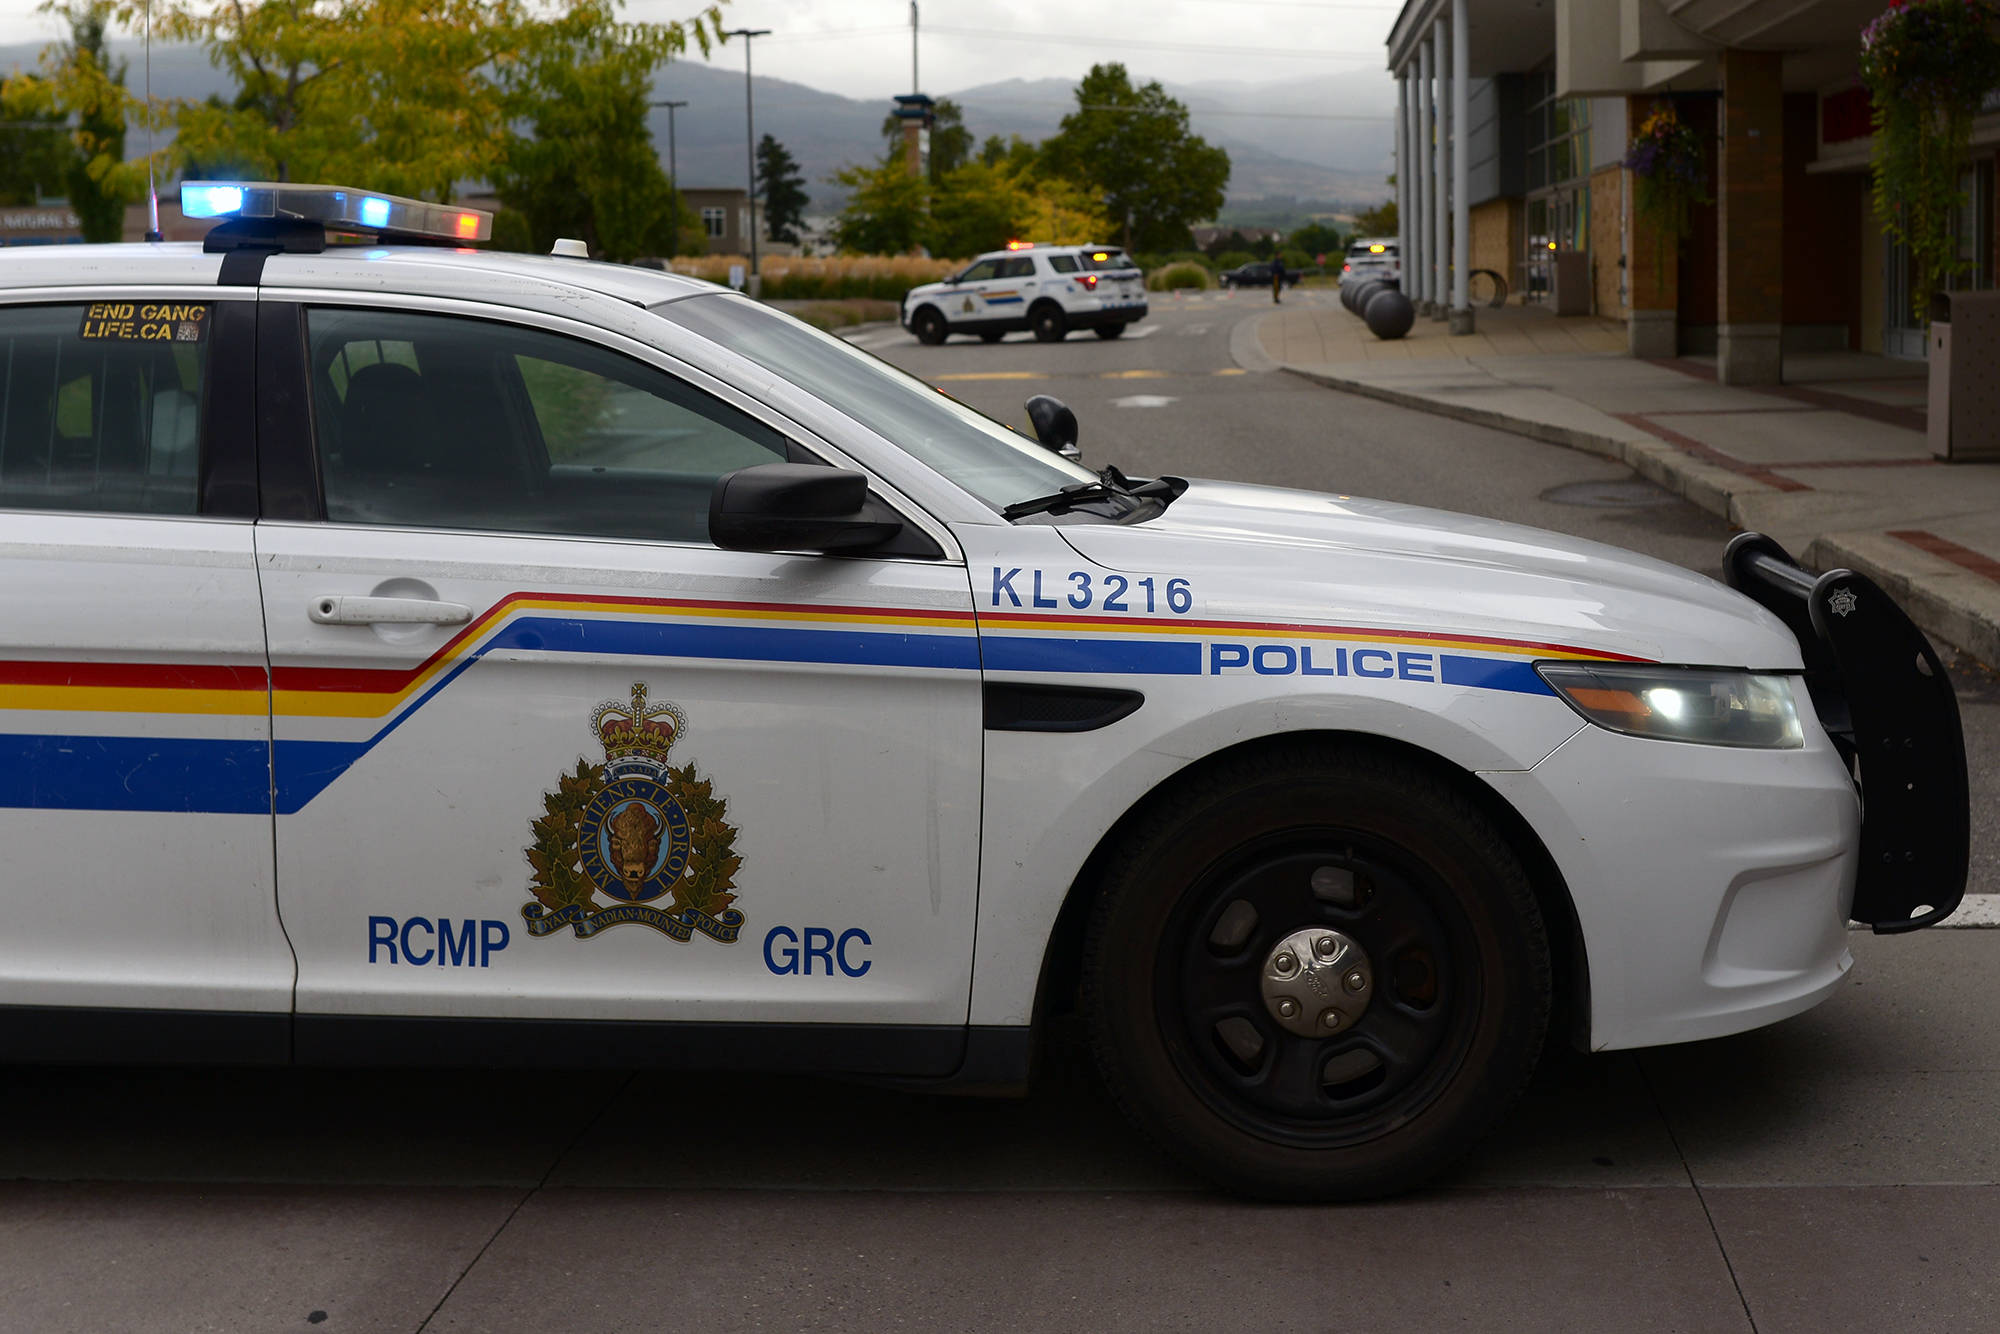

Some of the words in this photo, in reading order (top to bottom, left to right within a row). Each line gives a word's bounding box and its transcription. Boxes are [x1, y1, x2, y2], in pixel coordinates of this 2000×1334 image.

[83, 321, 172, 340] LIFE.CA
[88, 303, 135, 320] END
[140, 304, 206, 321] GANG
[991, 566, 1193, 614] KL3216
[1210, 643, 1436, 683] POLICE
[614, 764, 659, 777] CANADA
[649, 786, 676, 813] LE
[580, 781, 636, 888] MAINTIENS
[656, 824, 688, 890] DROIT
[368, 915, 510, 968] RCMP
[529, 910, 568, 932] ROYAL
[637, 909, 692, 939] MOUNTED
[696, 915, 738, 939] POLICE
[762, 926, 873, 977] GRC
